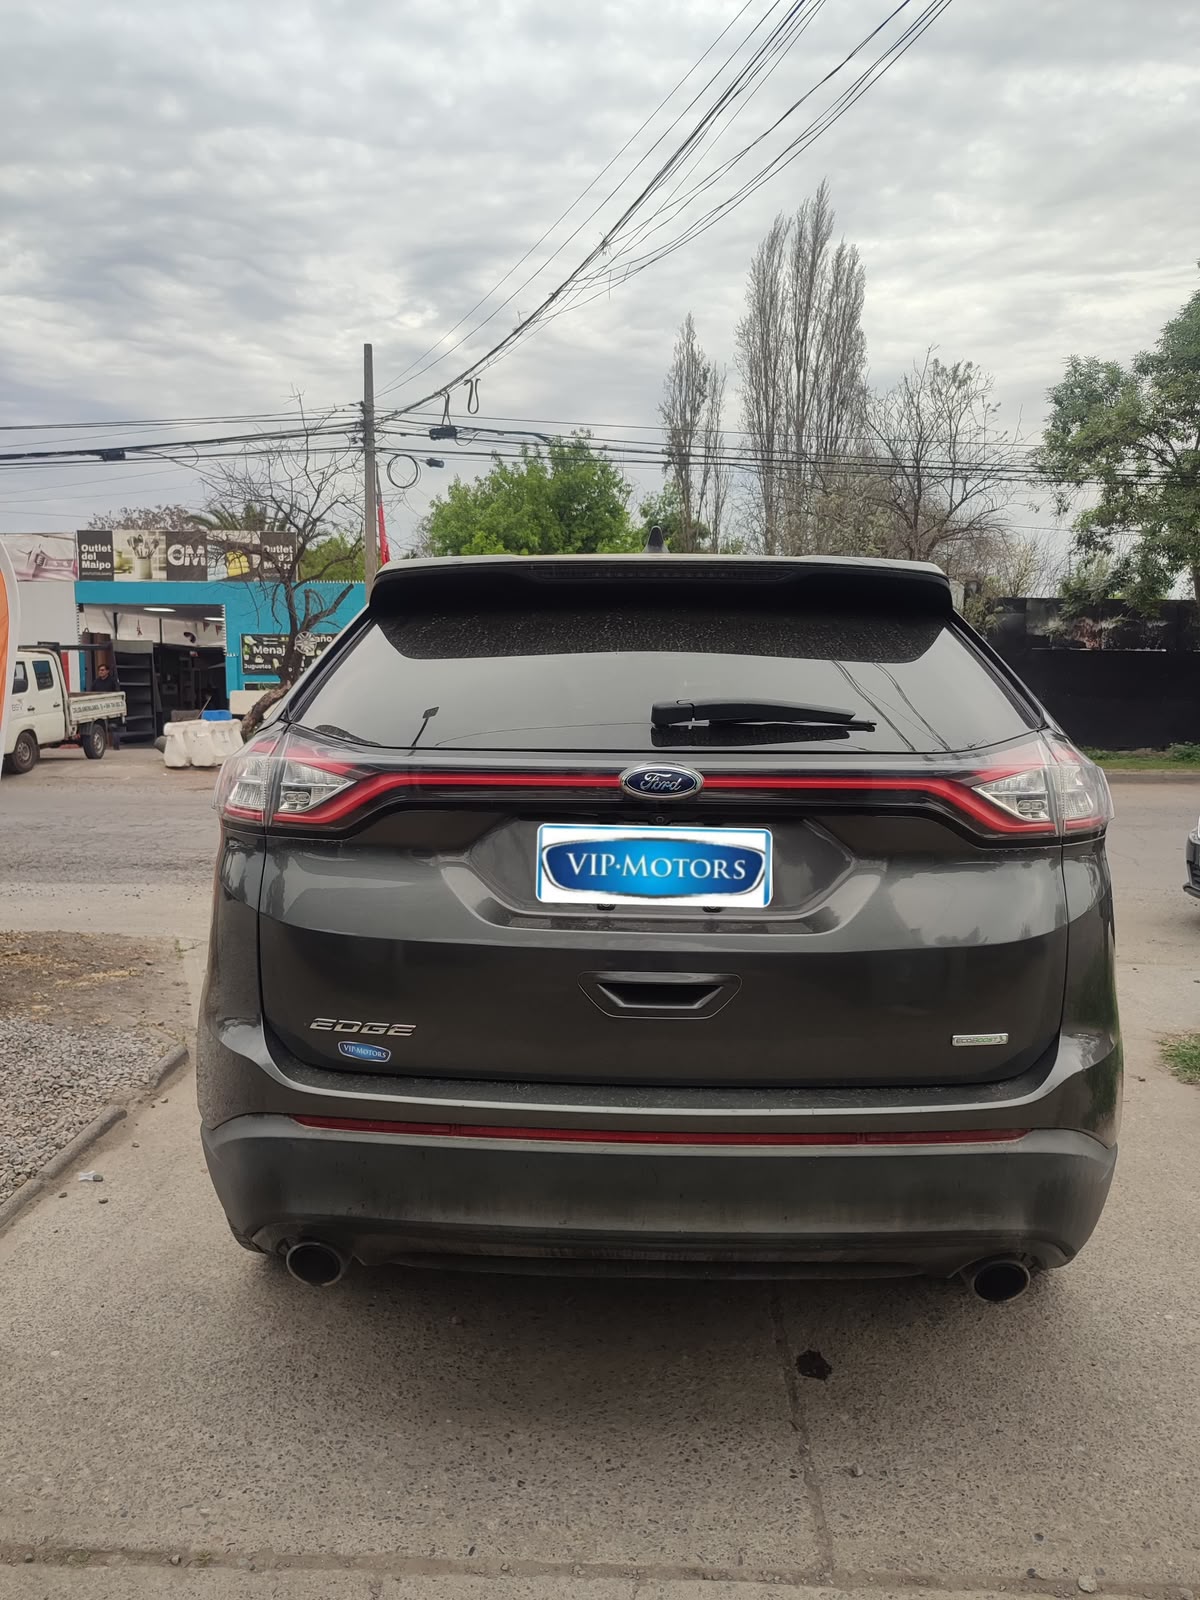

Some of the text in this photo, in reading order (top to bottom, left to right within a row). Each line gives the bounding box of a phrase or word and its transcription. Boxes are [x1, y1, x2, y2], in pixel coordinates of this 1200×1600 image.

[81, 544, 112, 553] Outlet
[81, 552, 97, 561] del
[81, 560, 112, 571] Maipo
[252, 645, 286, 657] Menaj
[640, 772, 683, 792] Ford
[309, 1017, 417, 1037] EDGE
